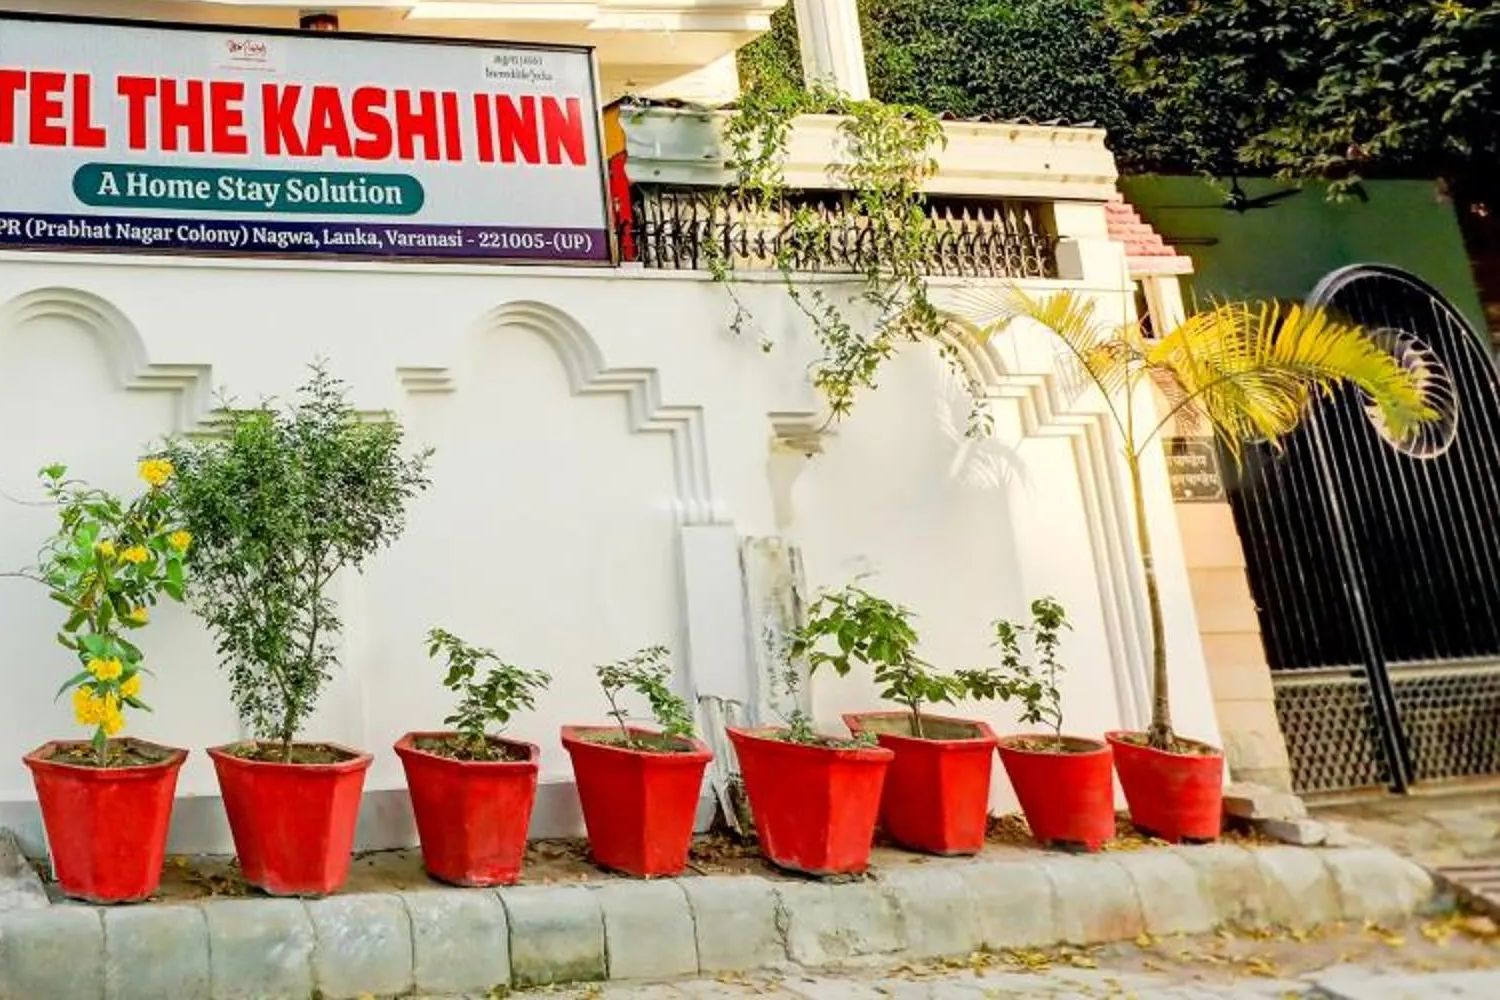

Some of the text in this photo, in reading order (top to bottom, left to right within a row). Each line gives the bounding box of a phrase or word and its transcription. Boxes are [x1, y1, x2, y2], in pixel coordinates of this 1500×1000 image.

[117, 75, 247, 154] THE
[261, 83, 463, 161] KASHI
[473, 94, 587, 166] INN
[97, 171, 403, 208] A Home Stay Solution
[25, 218, 112, 240] (Prabhat
[116, 223, 174, 244] Nagar
[177, 225, 249, 247] Colony)
[253, 227, 320, 248] Nagwa,
[323, 228, 383, 248] Lanka,
[384, 230, 463, 248] Varanasi
